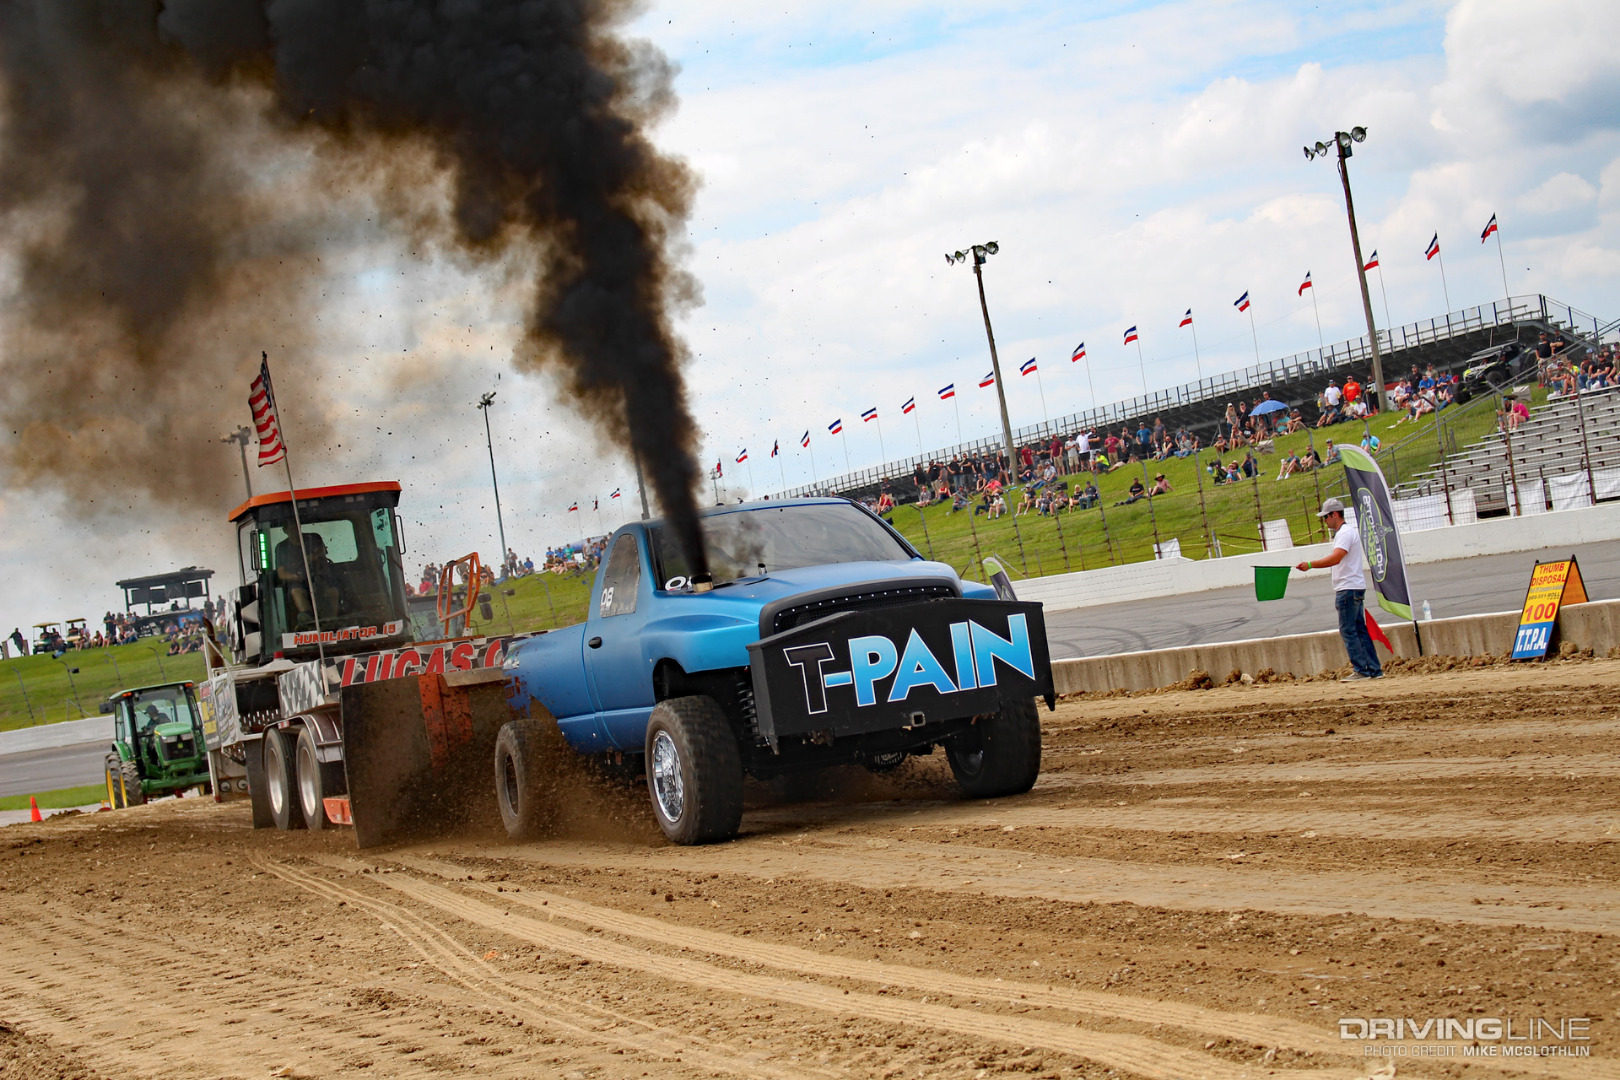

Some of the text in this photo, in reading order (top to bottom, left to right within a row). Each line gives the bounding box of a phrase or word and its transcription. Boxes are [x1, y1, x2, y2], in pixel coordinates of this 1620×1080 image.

[1539, 562, 1565, 575] THUMB
[1531, 573, 1566, 587] DISPOSAL
[600, 586, 614, 607] 08
[1525, 602, 1556, 622] 100
[294, 626, 377, 645] HUMILIATOR
[1516, 627, 1547, 653] T.T.P.A.
[783, 612, 1036, 715] T-PAIN
